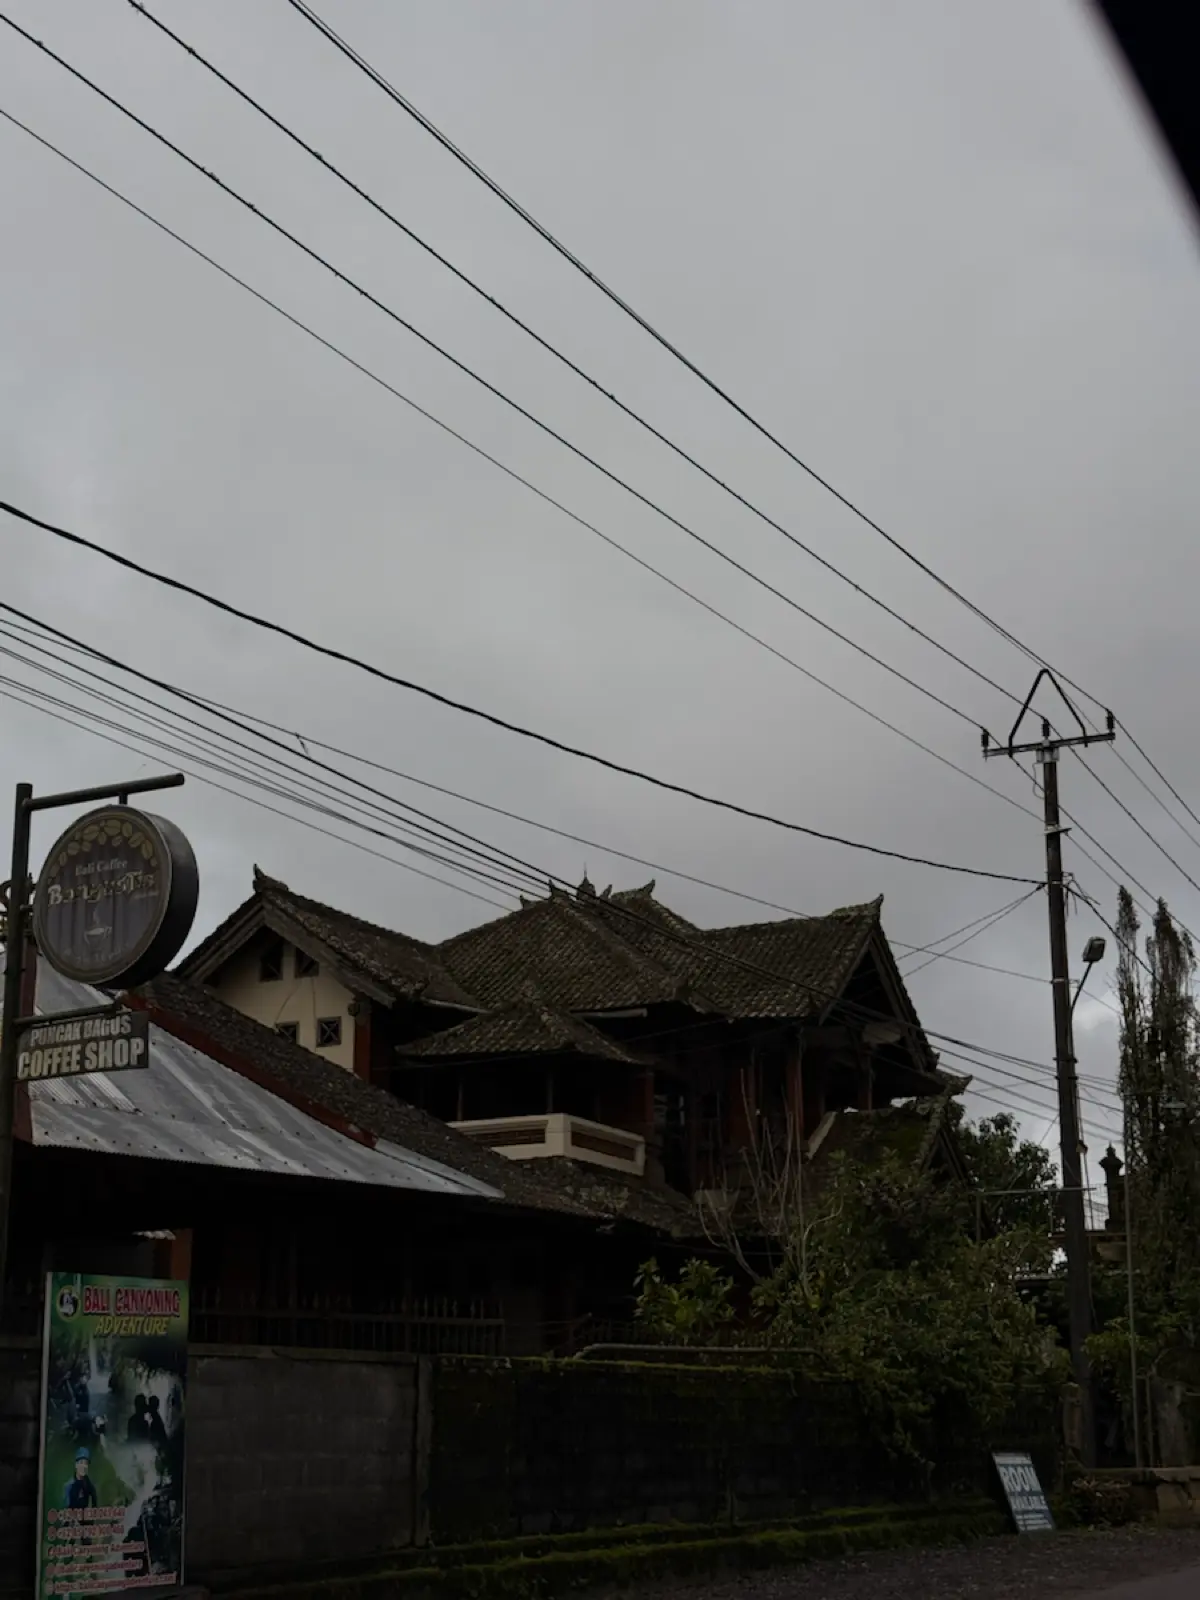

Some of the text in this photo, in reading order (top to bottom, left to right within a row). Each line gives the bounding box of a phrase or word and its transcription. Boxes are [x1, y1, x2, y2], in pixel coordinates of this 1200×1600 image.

[30, 1014, 132, 1047] PUNCAK BAGUS
[17, 1036, 145, 1079] COFFEE SHOP
[83, 1286, 180, 1315] BALI CANYONING
[95, 1315, 170, 1336] ADVENTURE
[999, 1465, 1042, 1492] ROOM
